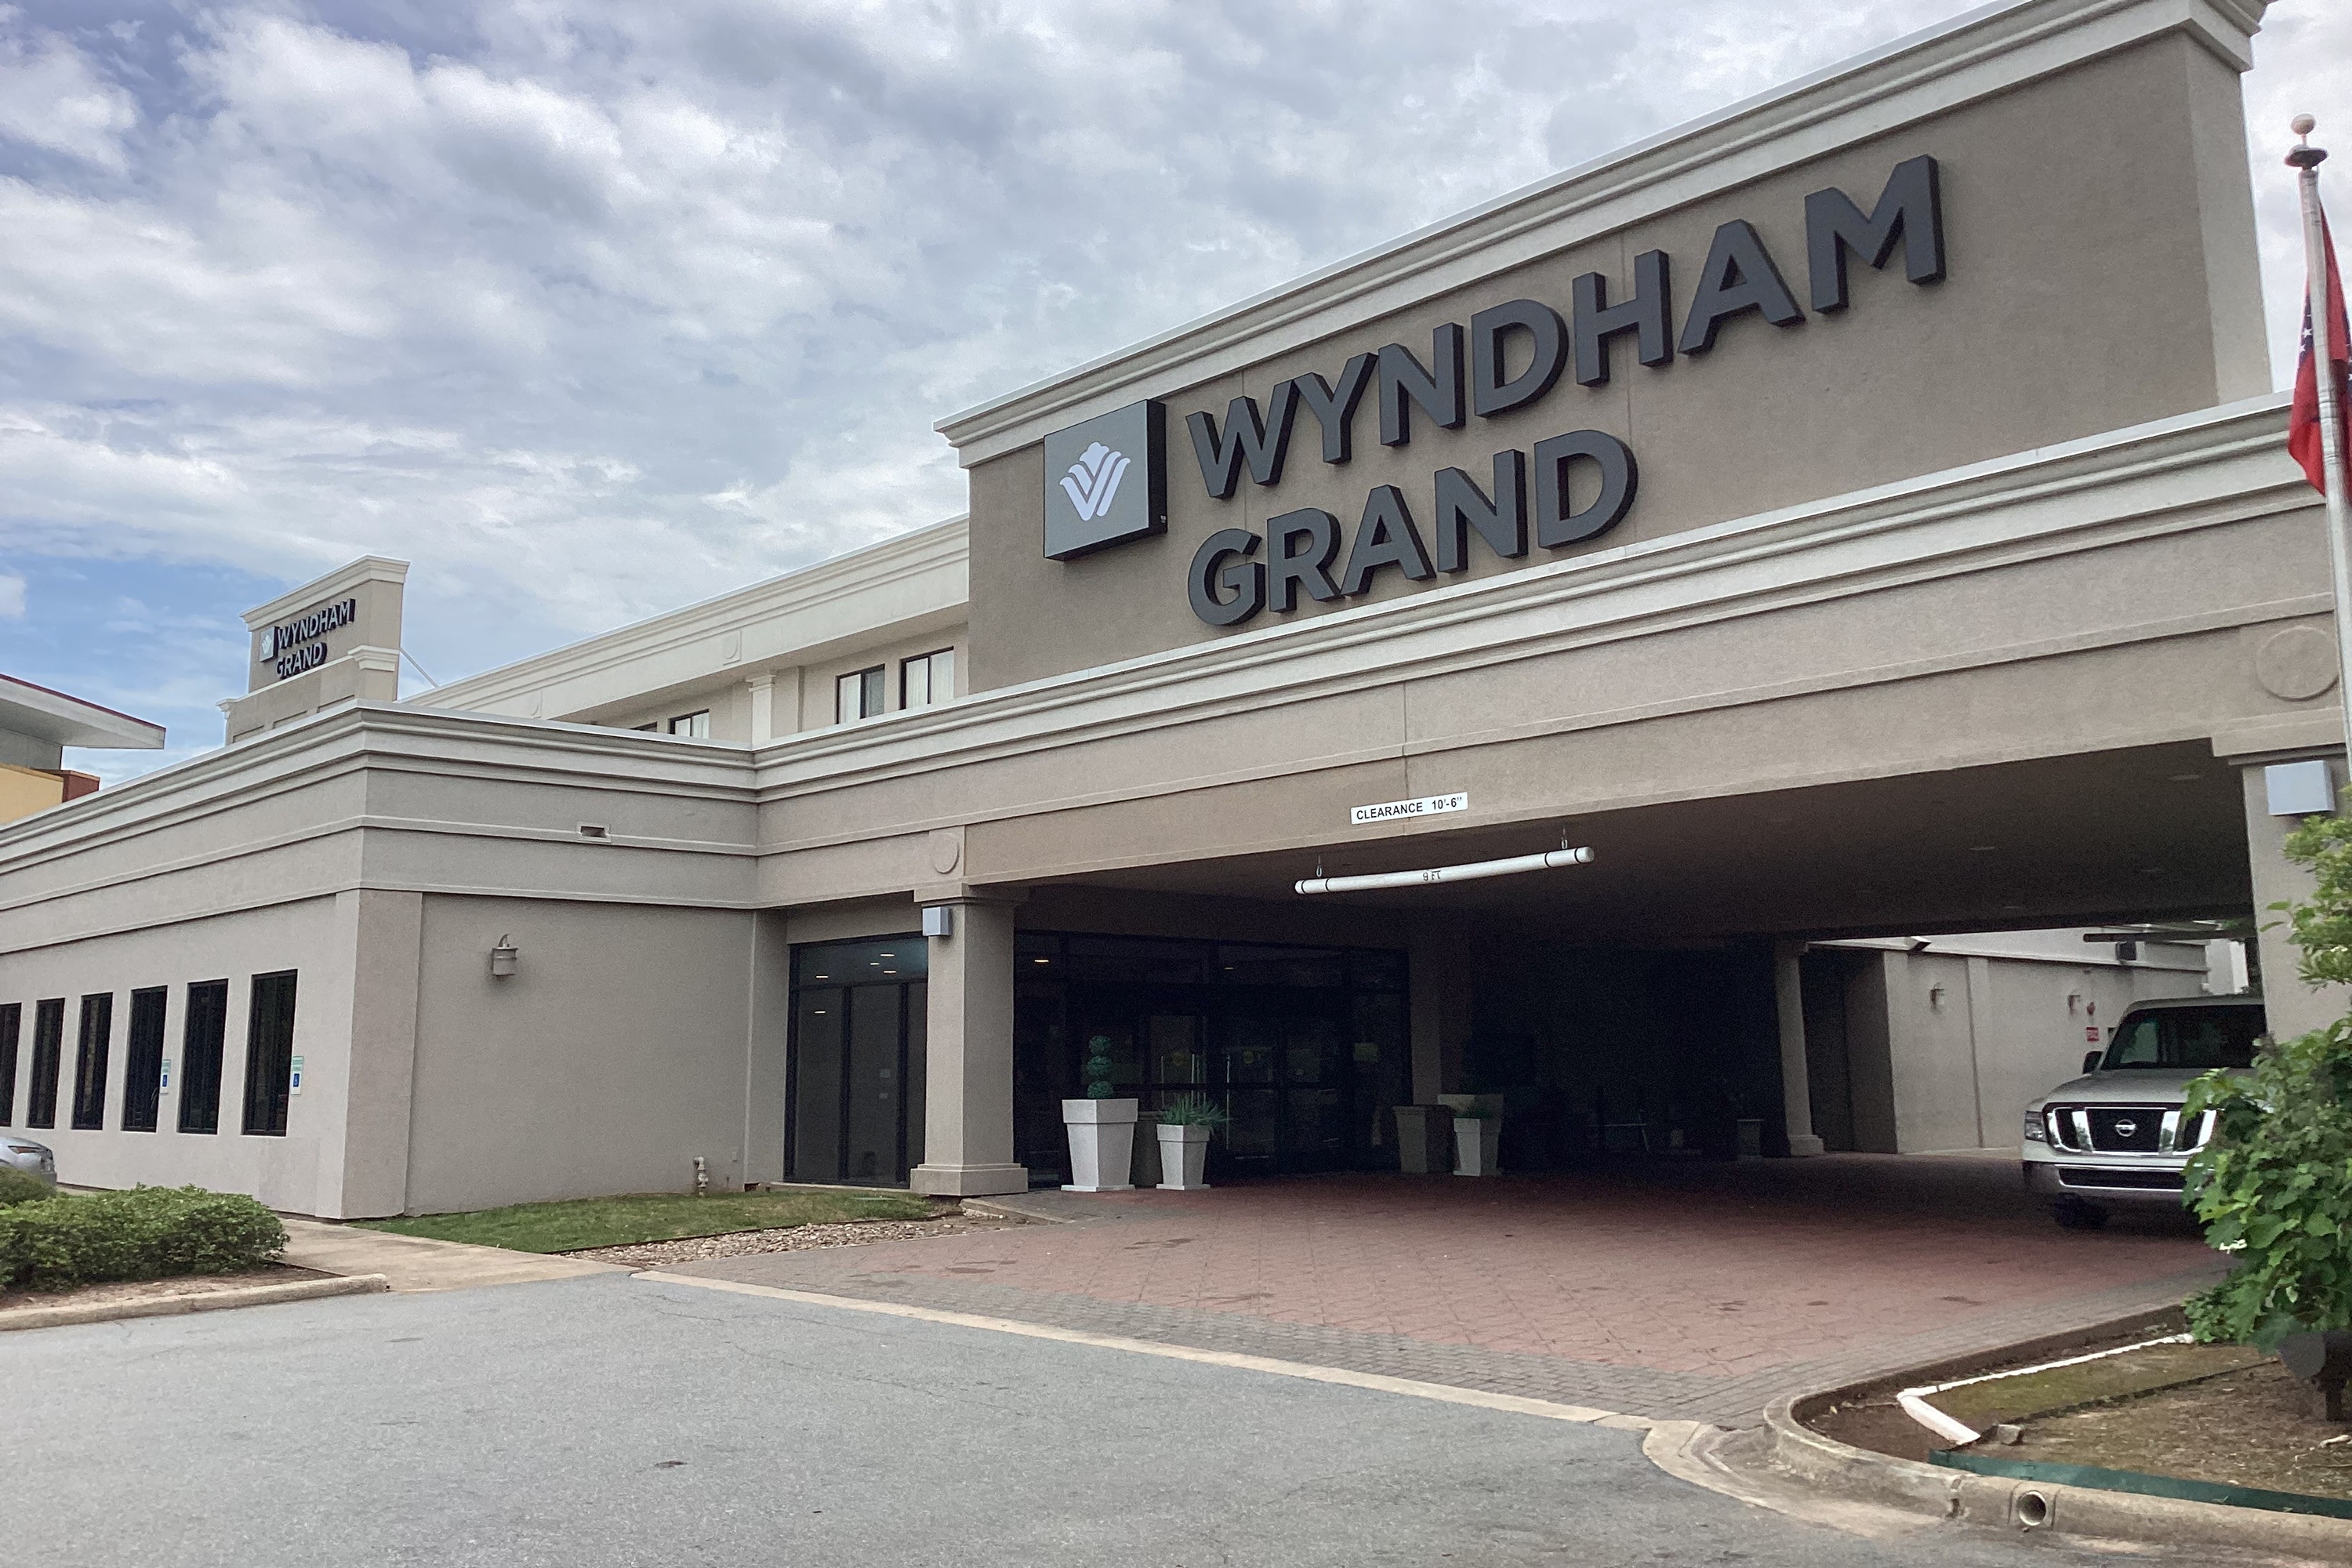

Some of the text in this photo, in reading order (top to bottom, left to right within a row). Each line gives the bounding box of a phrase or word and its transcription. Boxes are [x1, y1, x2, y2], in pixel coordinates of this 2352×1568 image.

[1185, 154, 1946, 499] WYNDHAM
[1187, 429, 1638, 626] GRAND
[278, 598, 356, 649] WYNDHAM
[276, 642, 327, 679] GRAND
[1356, 802, 1423, 820] CLEARANCE
[1422, 870, 1441, 881] 9 FT
